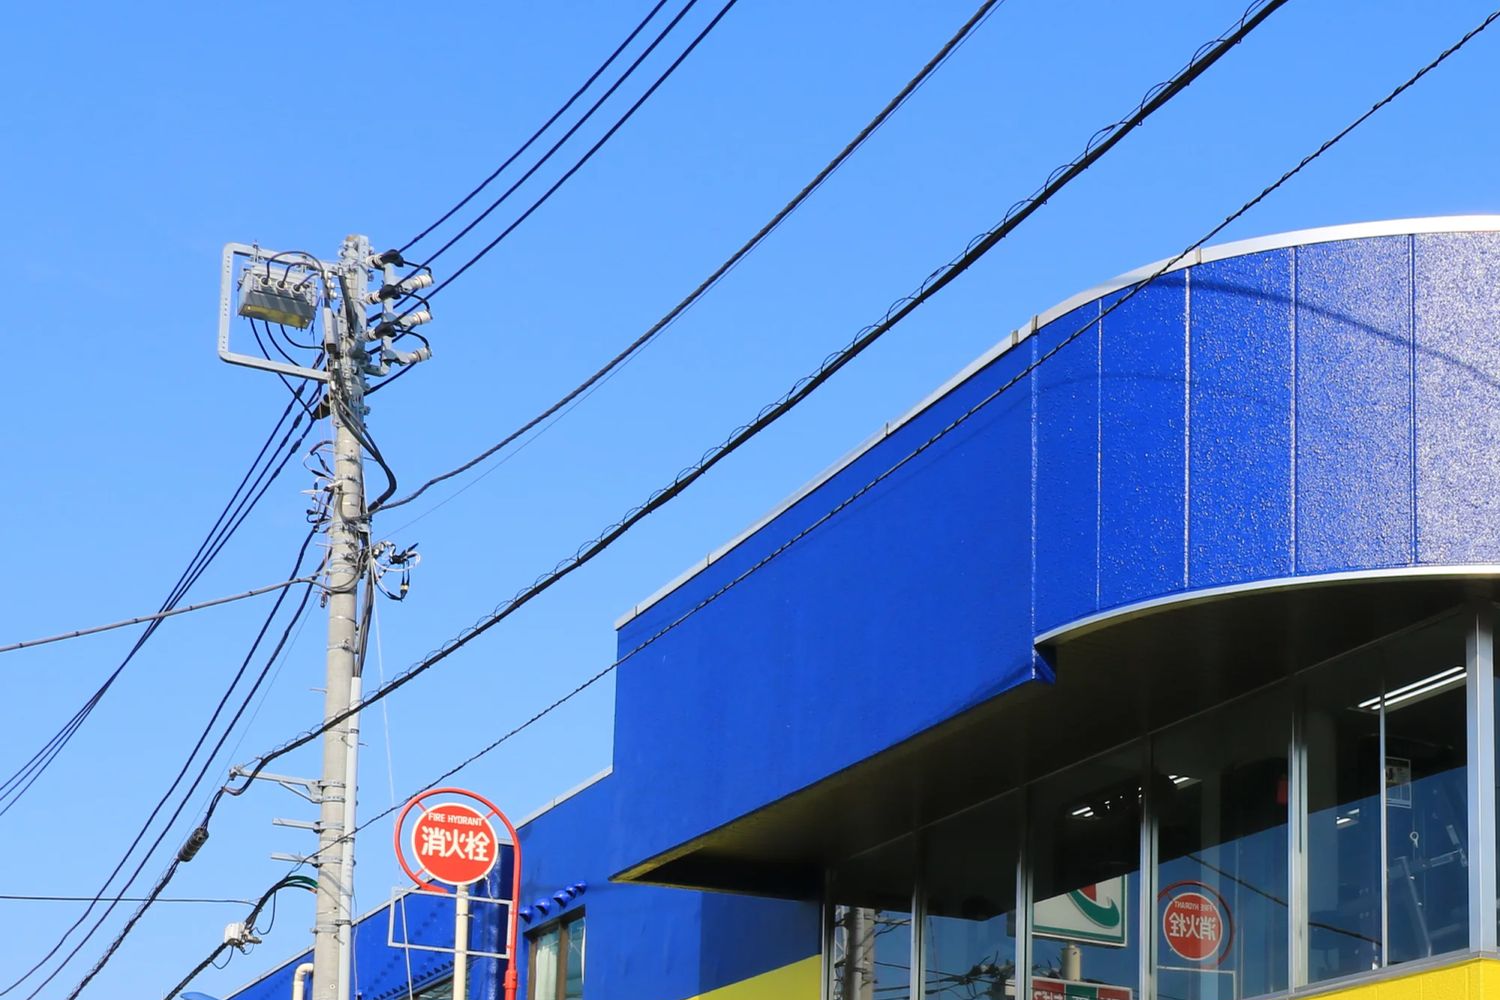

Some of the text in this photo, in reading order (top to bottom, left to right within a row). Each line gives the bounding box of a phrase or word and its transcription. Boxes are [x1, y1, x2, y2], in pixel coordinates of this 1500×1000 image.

[428, 812, 483, 826] FIRE HYDRANT
[421, 825, 490, 862] 消火栓
